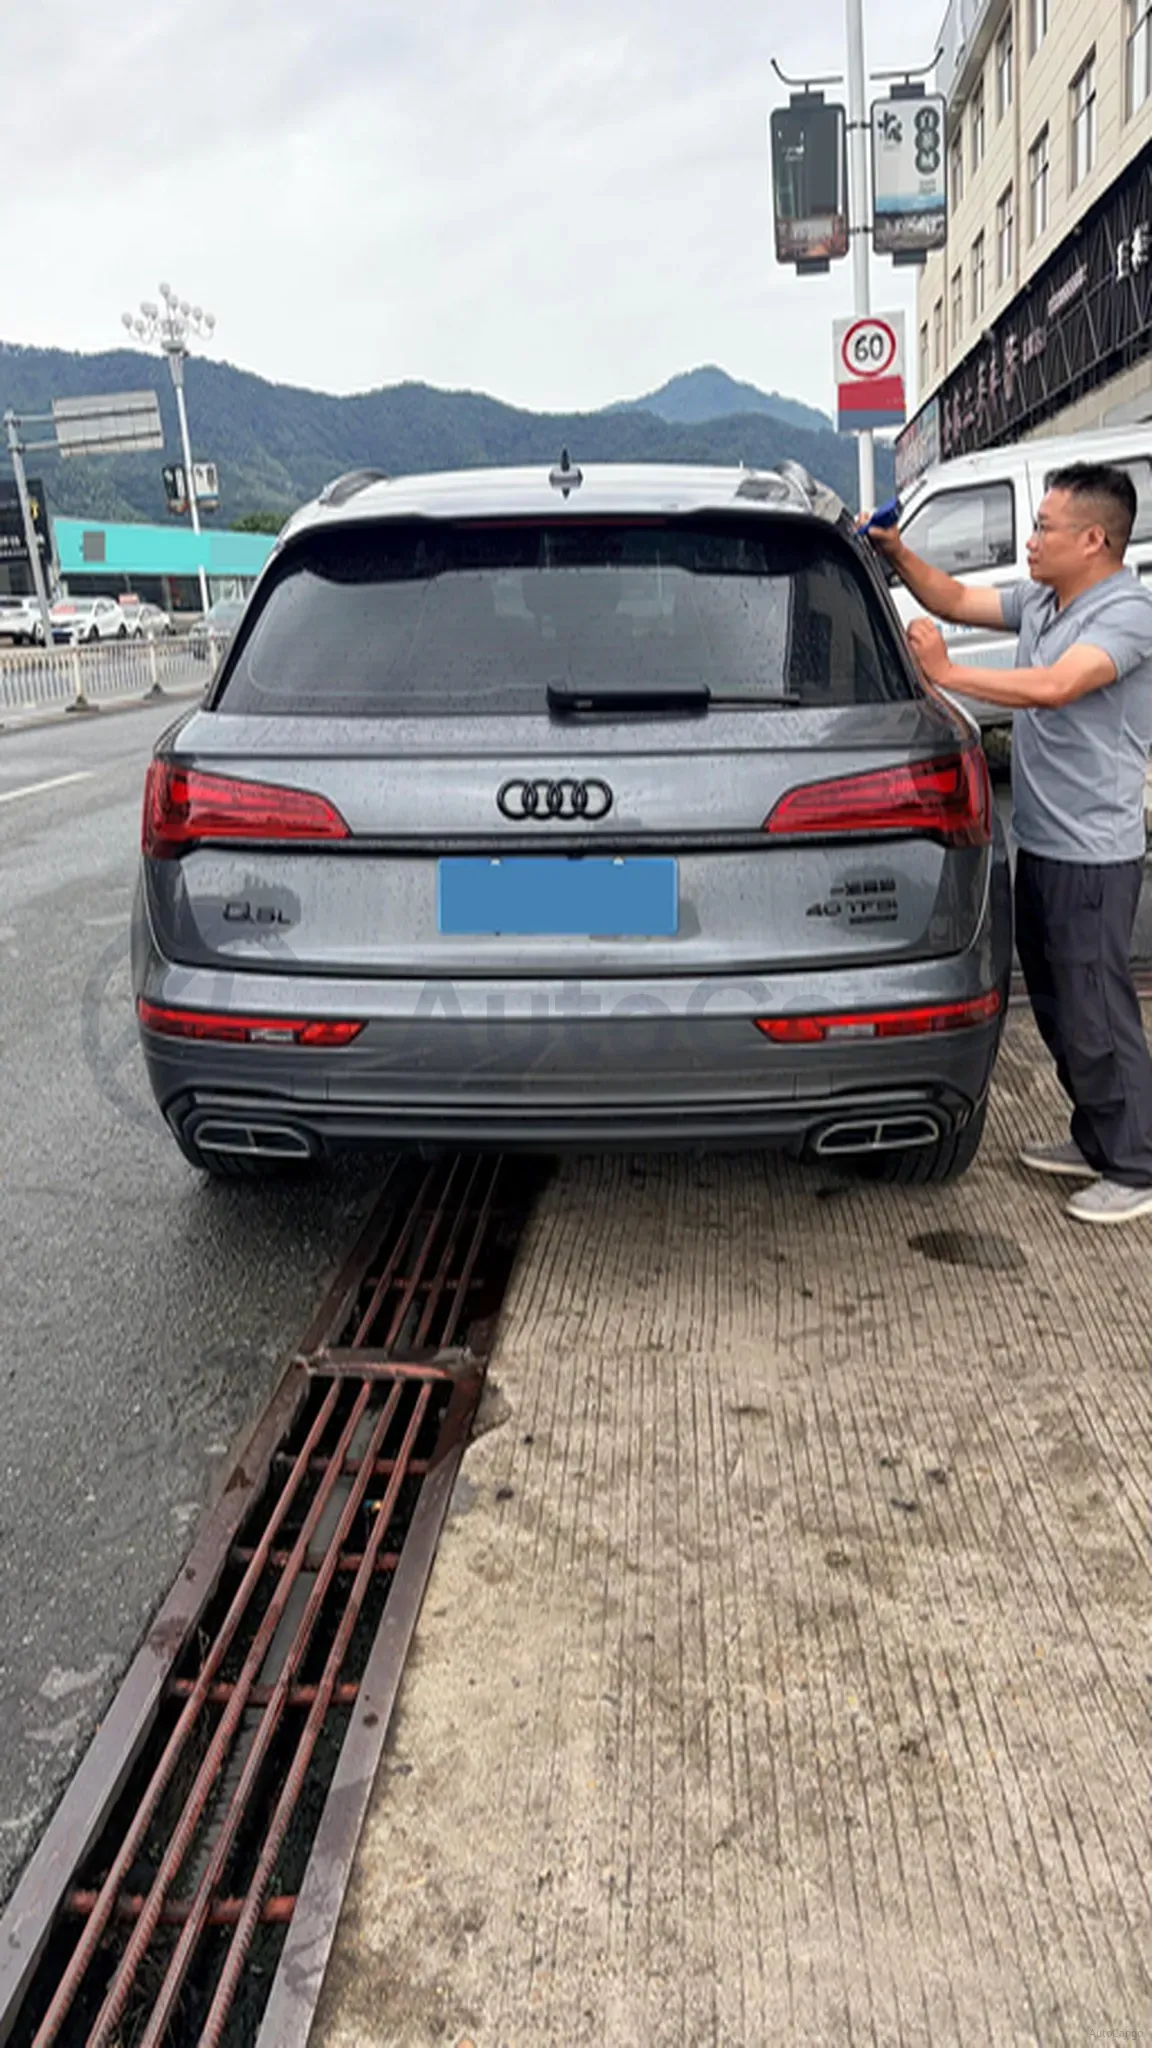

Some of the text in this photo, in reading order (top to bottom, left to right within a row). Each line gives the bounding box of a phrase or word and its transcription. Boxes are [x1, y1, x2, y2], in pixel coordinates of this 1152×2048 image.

[854, 333, 884, 363] 60
[805, 898, 898, 917] 40 TFSI
